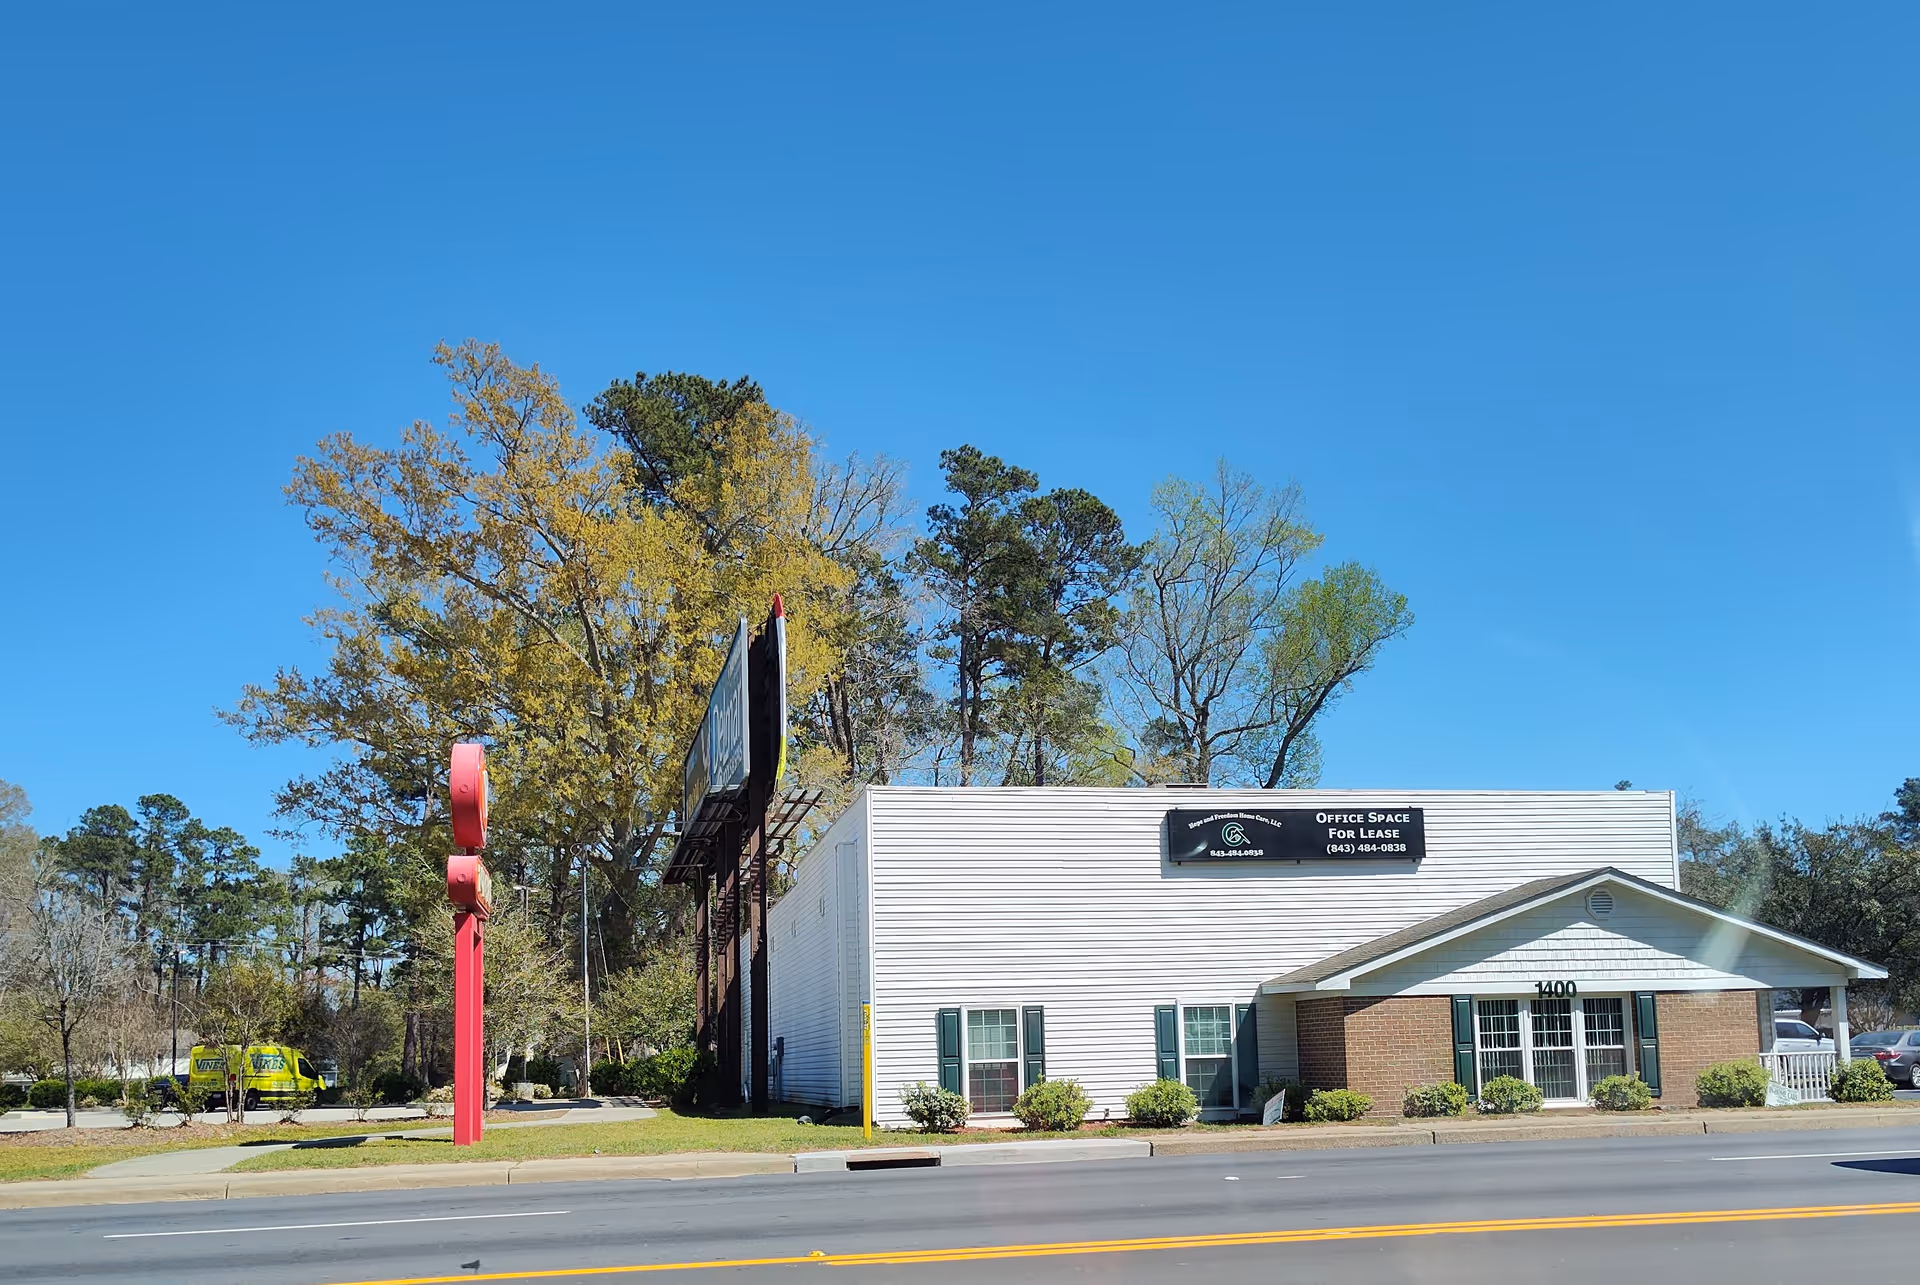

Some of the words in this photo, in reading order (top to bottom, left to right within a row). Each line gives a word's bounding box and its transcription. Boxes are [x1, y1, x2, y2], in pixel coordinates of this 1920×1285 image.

[1188, 820, 1203, 830] Hope
[1203, 815, 1214, 824] and
[1214, 812, 1239, 821] Freedom
[1239, 812, 1255, 820] Home
[1255, 814, 1270, 825] Care,
[1270, 818, 1283, 829] LLC
[1326, 844, 1355, 855] (843)
[1357, 844, 1407, 853] 484-0838
[1535, 980, 1577, 998] 1400
